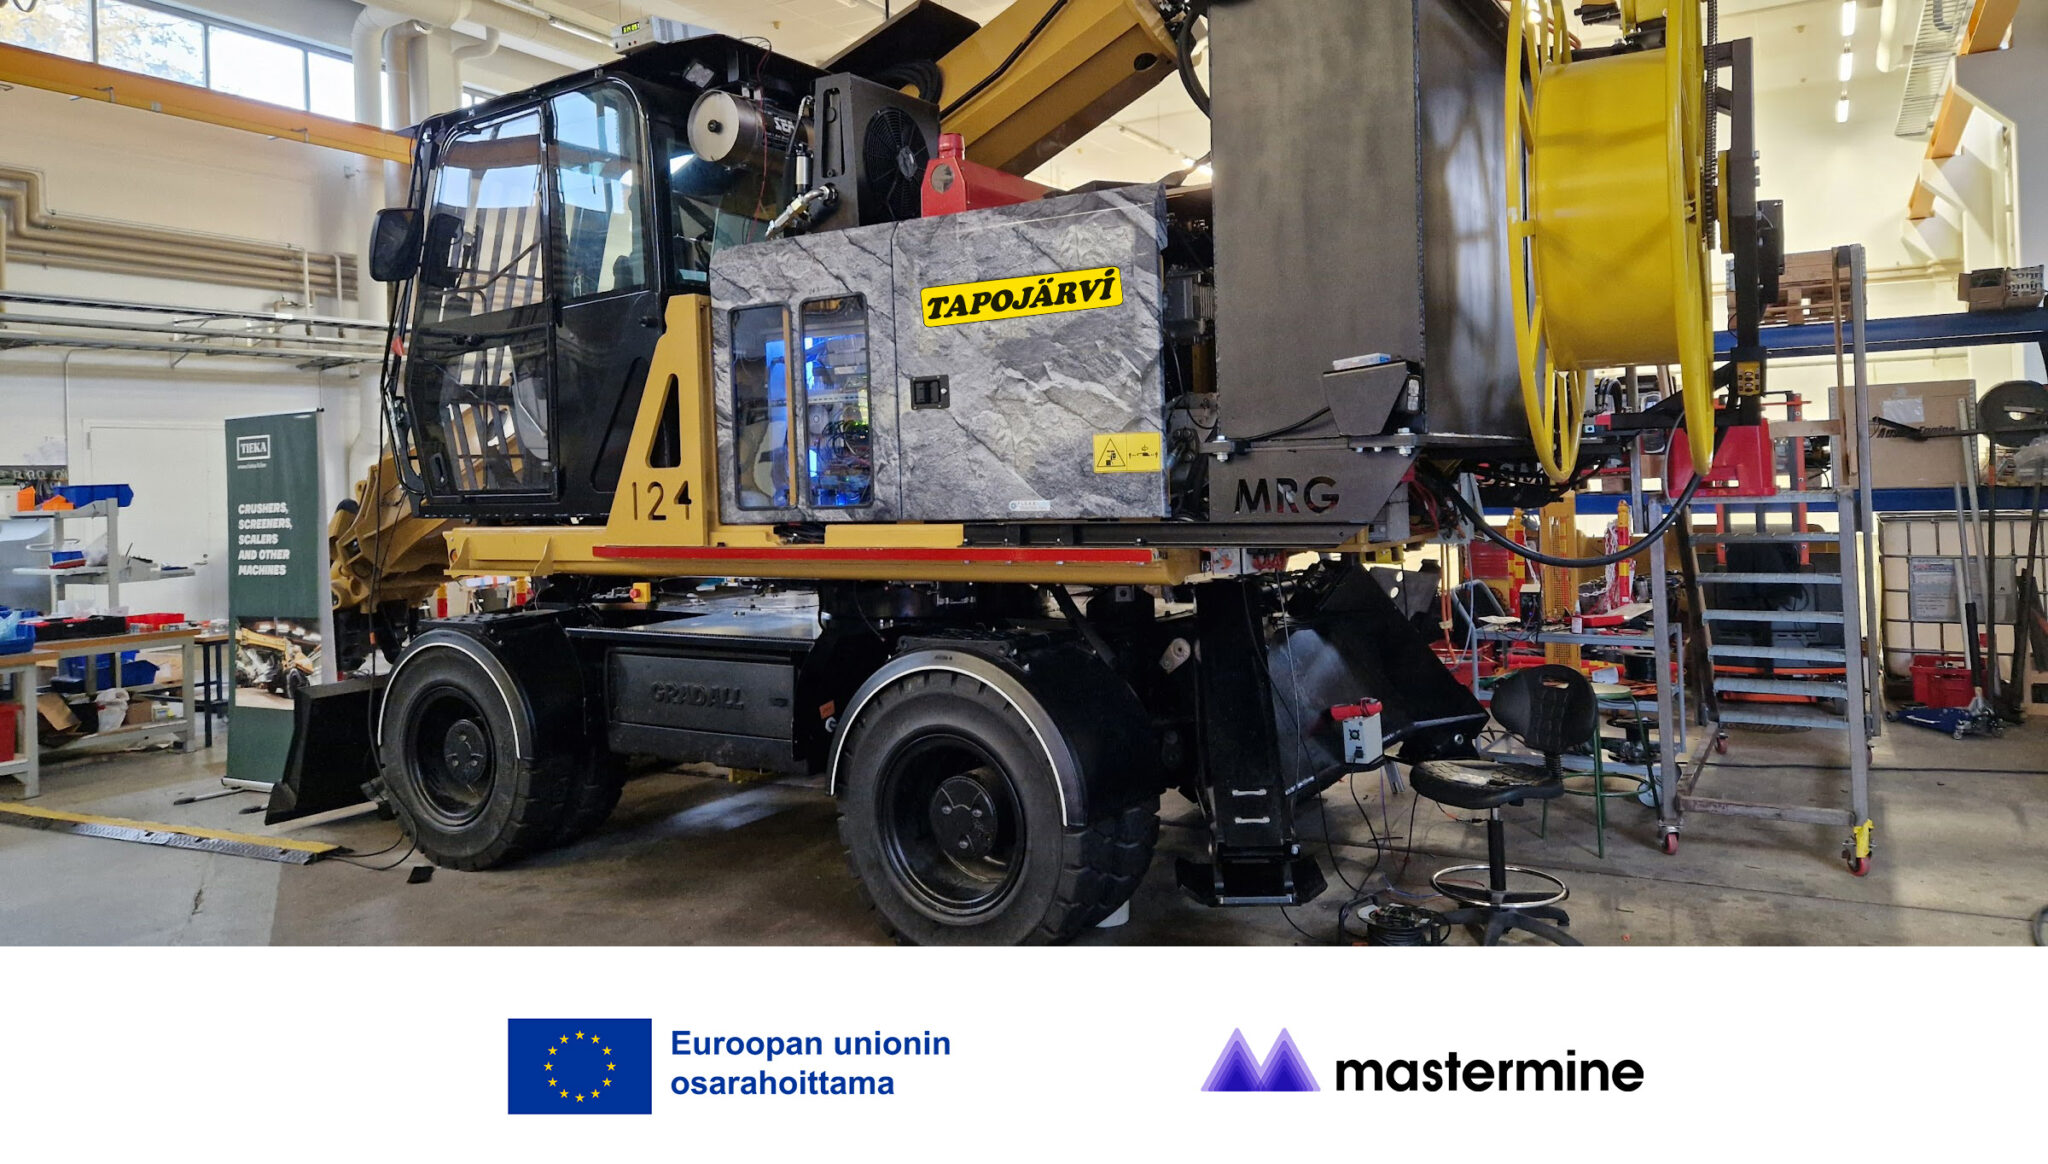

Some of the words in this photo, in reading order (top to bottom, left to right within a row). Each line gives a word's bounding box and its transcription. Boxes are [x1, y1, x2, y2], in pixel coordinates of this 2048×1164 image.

[240, 441, 267, 454] TIEKA
[632, 480, 692, 521] 124
[1234, 476, 1339, 514] MRG
[238, 502, 289, 515] CRUSHERS,
[238, 518, 293, 530] SCREENERS,
[238, 533, 279, 545] SCALERS
[238, 549, 257, 560] AND
[258, 549, 291, 560] OTHER
[238, 564, 287, 576] MACHINES
[650, 680, 744, 711] GRADALL
